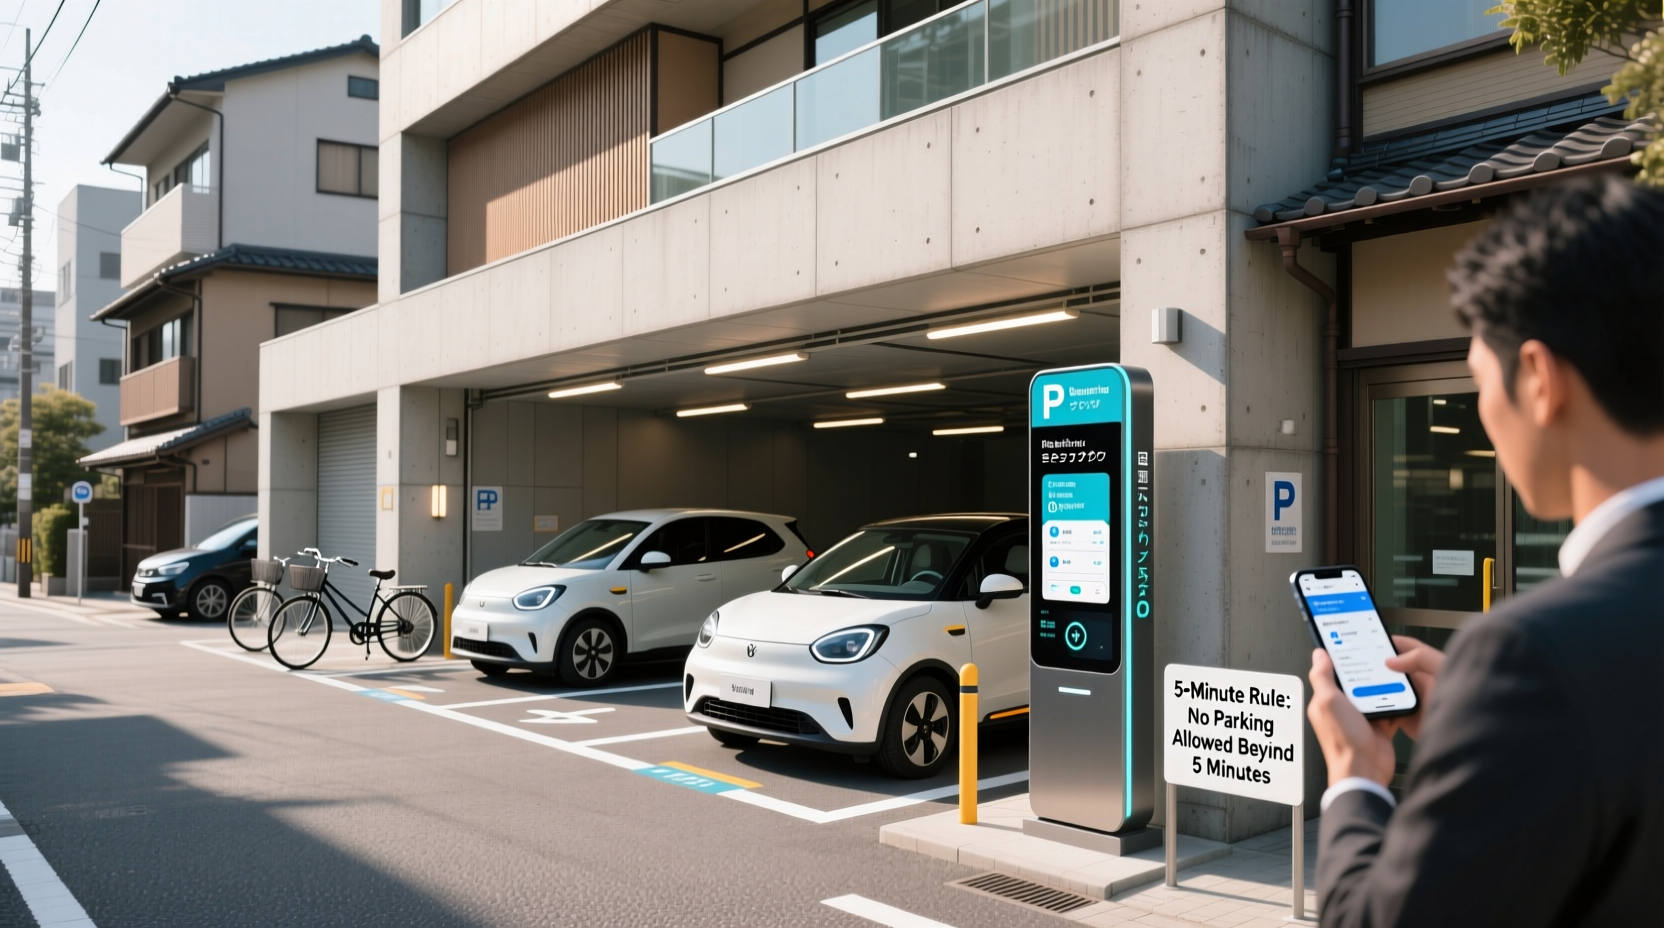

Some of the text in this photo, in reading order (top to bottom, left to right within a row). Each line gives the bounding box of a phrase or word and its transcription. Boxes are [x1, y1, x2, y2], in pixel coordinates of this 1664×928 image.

[1043, 384, 1065, 420] P
[1274, 480, 1296, 521] P
[1174, 679, 1291, 709] 5-Minute Rule:
[1188, 706, 1274, 738] No Parking
[1172, 728, 1294, 763] Allowed Beyind
[1192, 755, 1271, 785] 5 Minutes
